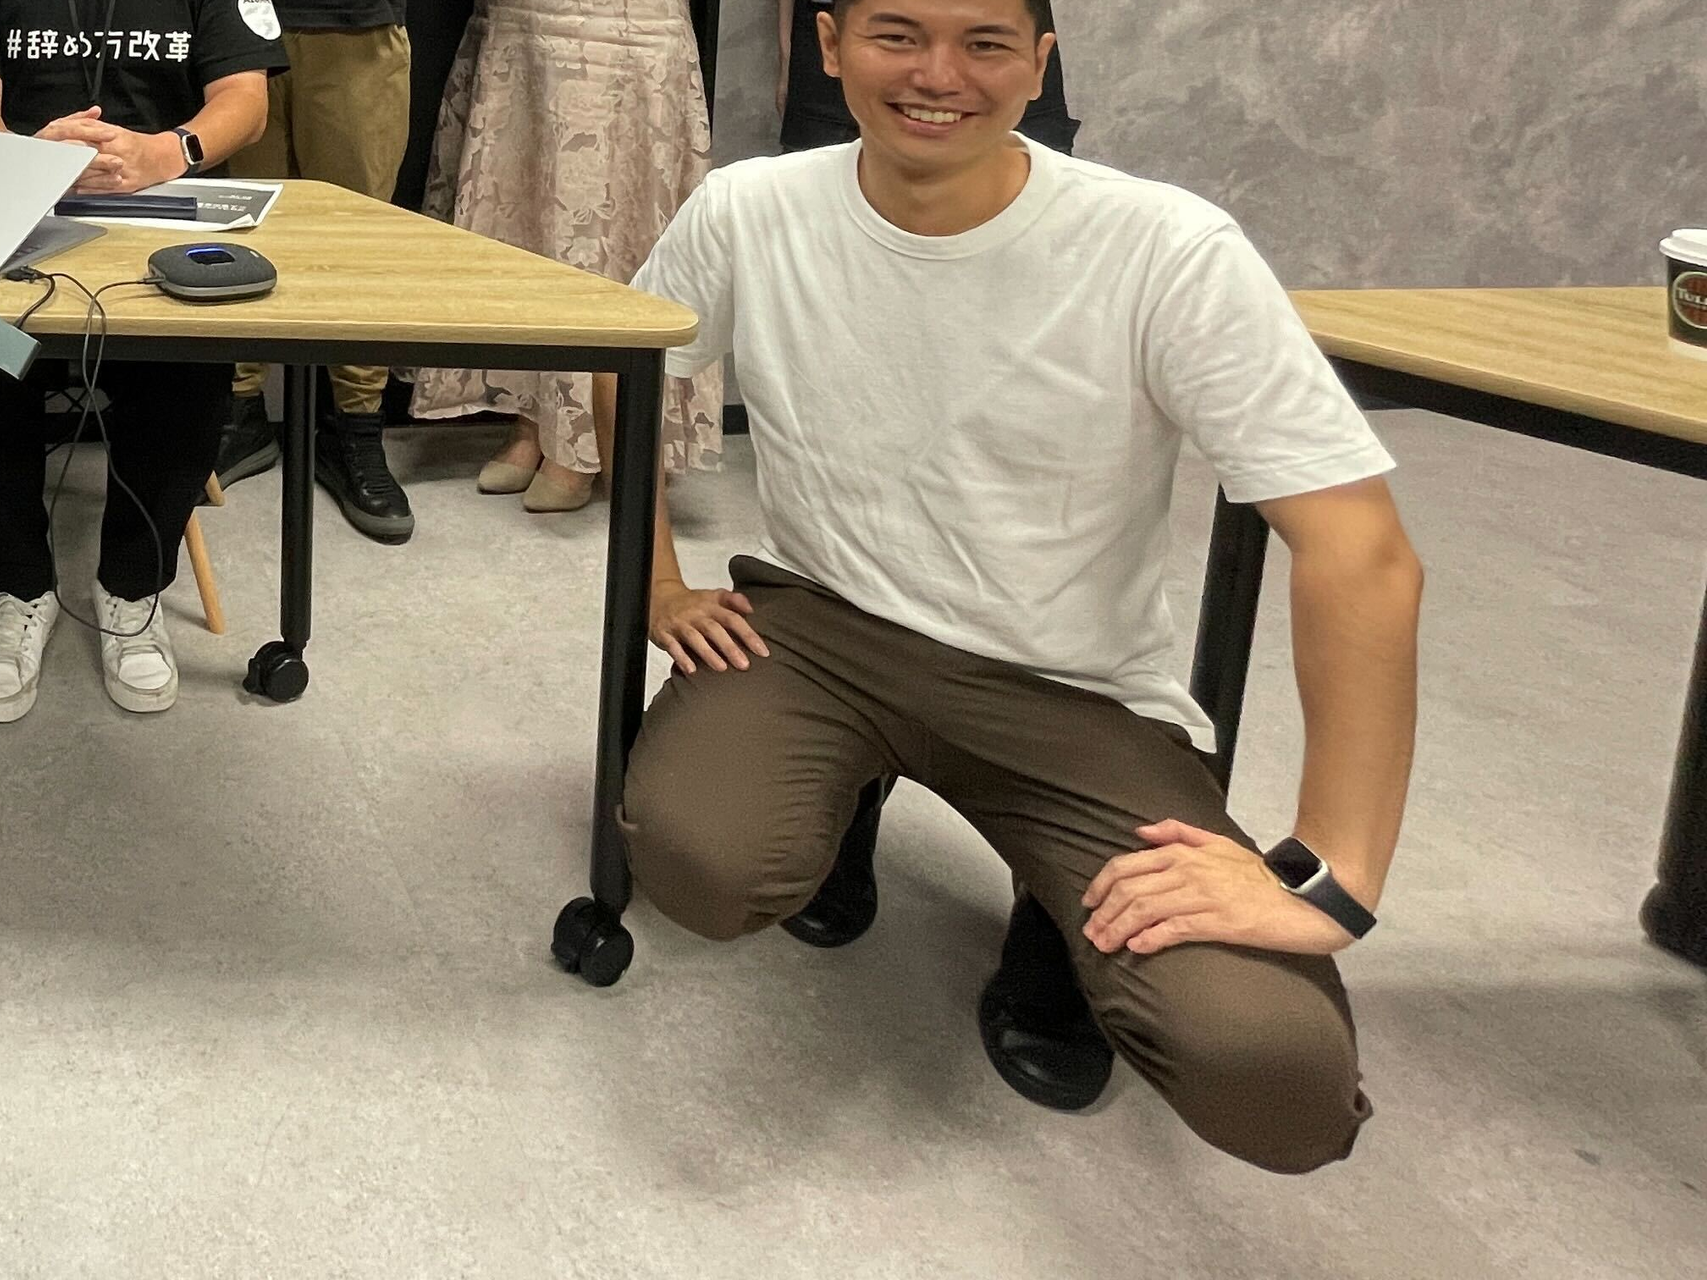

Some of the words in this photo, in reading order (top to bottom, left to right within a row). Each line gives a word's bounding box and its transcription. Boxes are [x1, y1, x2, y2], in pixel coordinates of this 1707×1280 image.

[7, 29, 192, 62] #辞め方改革
